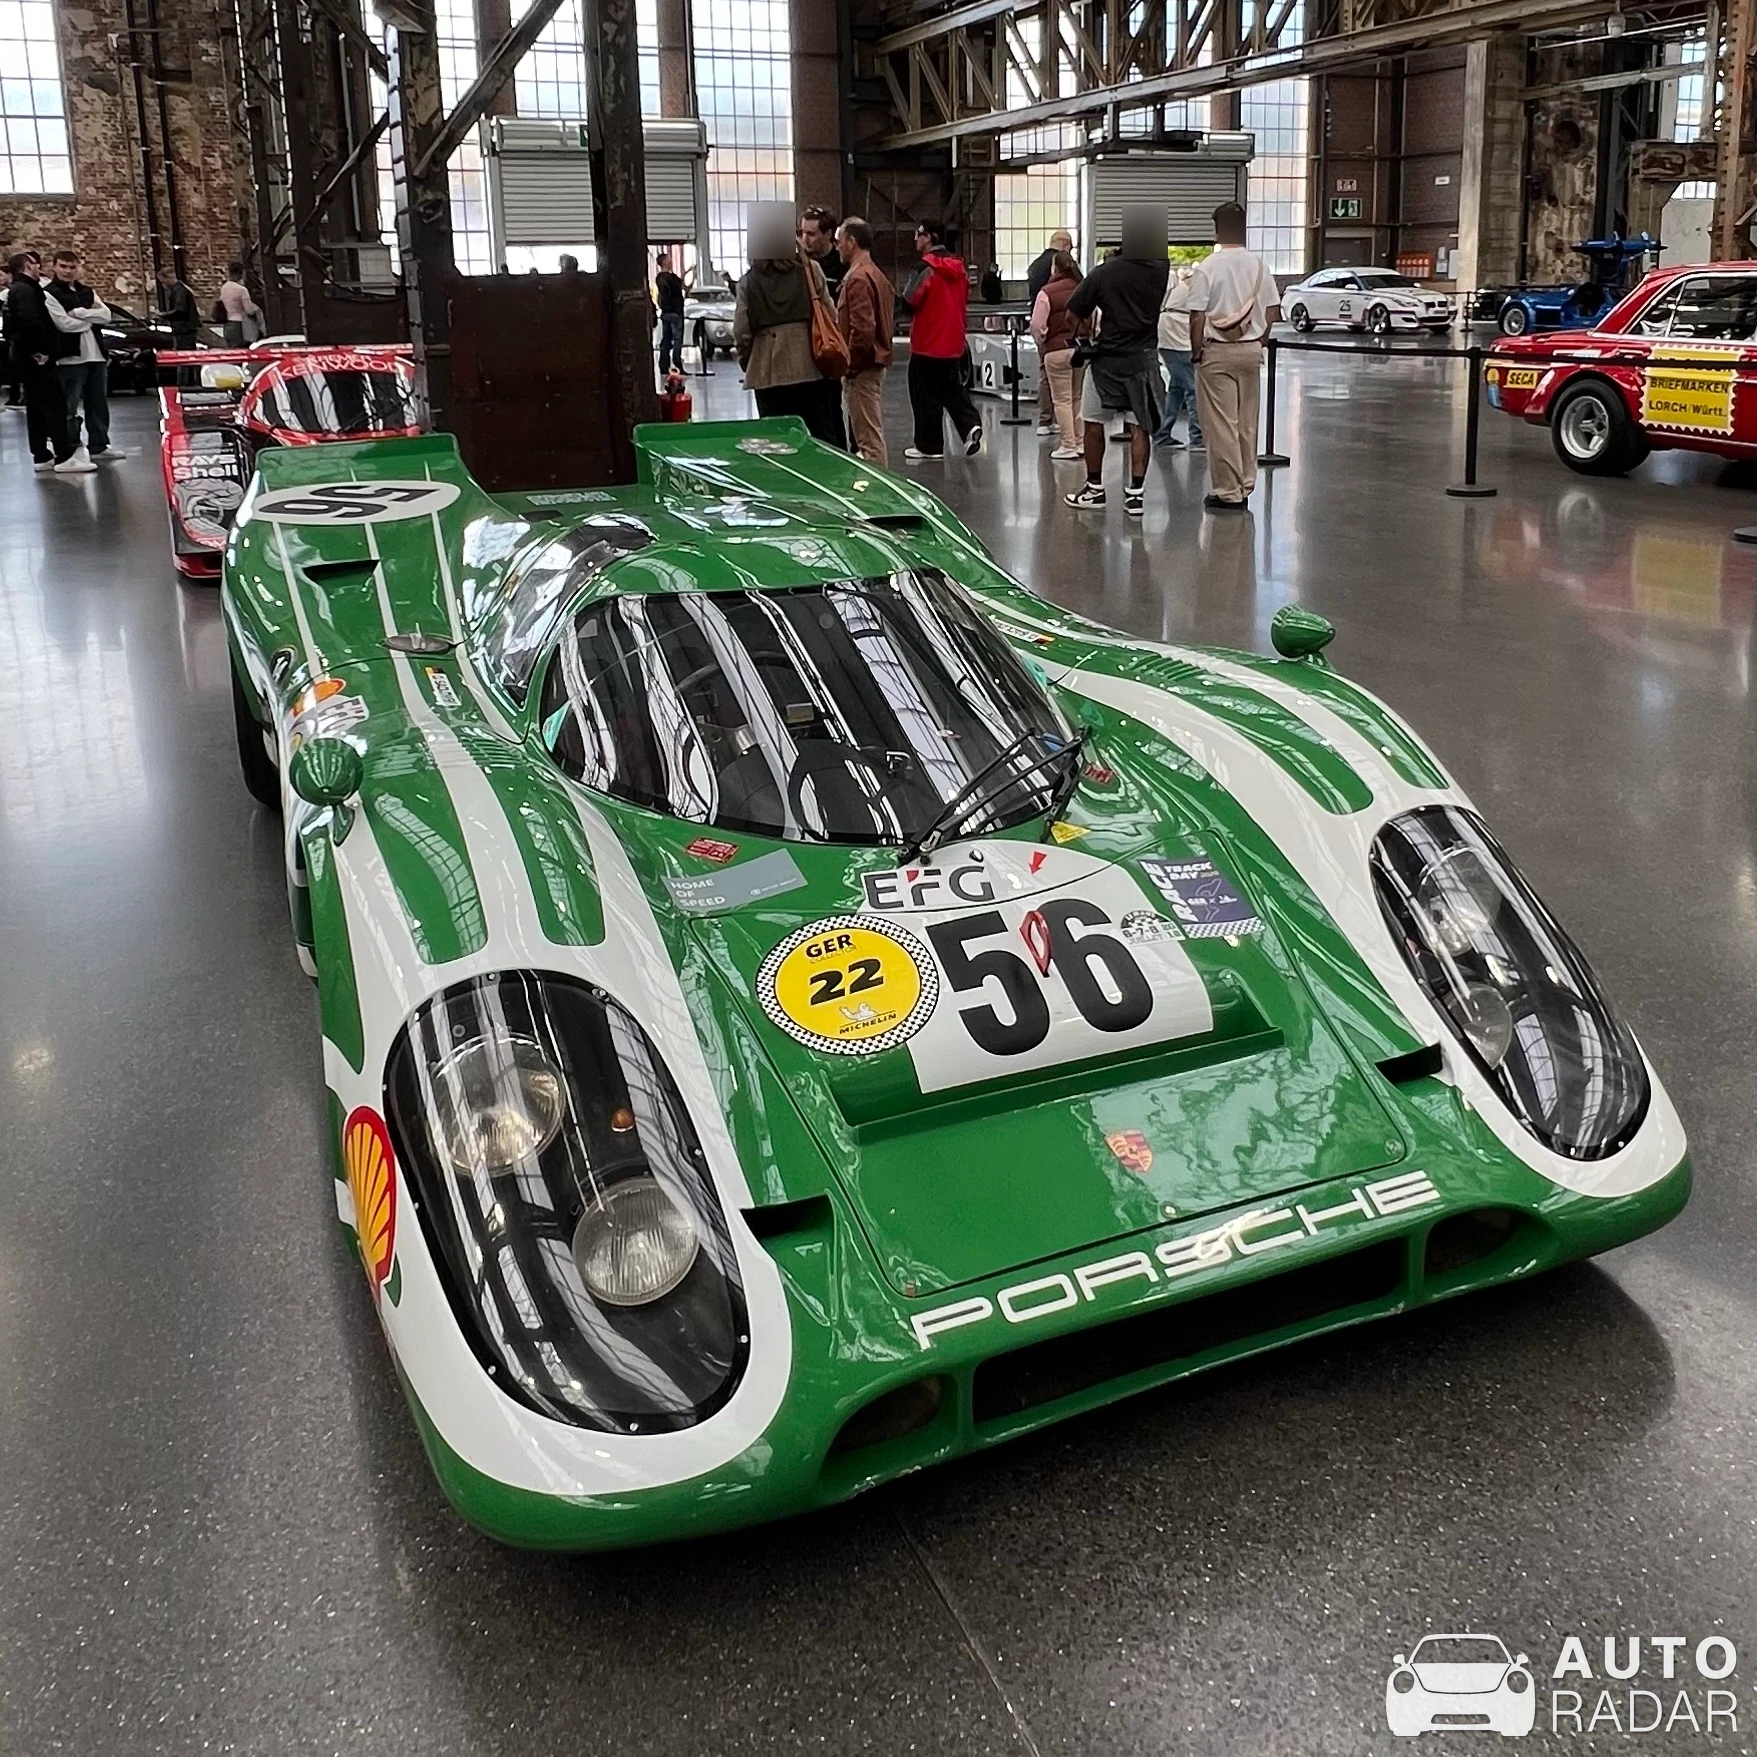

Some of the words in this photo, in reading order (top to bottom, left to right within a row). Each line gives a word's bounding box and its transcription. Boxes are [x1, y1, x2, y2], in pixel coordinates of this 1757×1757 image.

[1339, 299, 1351, 311] 25
[281, 360, 402, 377] KENWOOD
[984, 363, 993, 387] 2
[1508, 372, 1534, 386] SECA
[1650, 377, 1728, 393] BRIEFMARKEN
[1648, 400, 1687, 413] LORCH
[172, 454, 236, 467] RAYS
[258, 486, 440, 519] 56
[1164, 861, 1212, 873] TRACK
[1169, 871, 1198, 880] DAY
[670, 879, 714, 890] HOME
[864, 866, 995, 910] EFG
[1140, 861, 1199, 922] RACE
[675, 890, 695, 898] OF
[680, 896, 726, 907] SPEED
[1122, 926, 1159, 938] 6-7-8
[806, 934, 853, 958] GER
[810, 959, 884, 1006] 22
[925, 898, 1154, 1056] 56
[839, 1012, 897, 1036] MICHELIN
[910, 1170, 1441, 1350] PORSCHE
